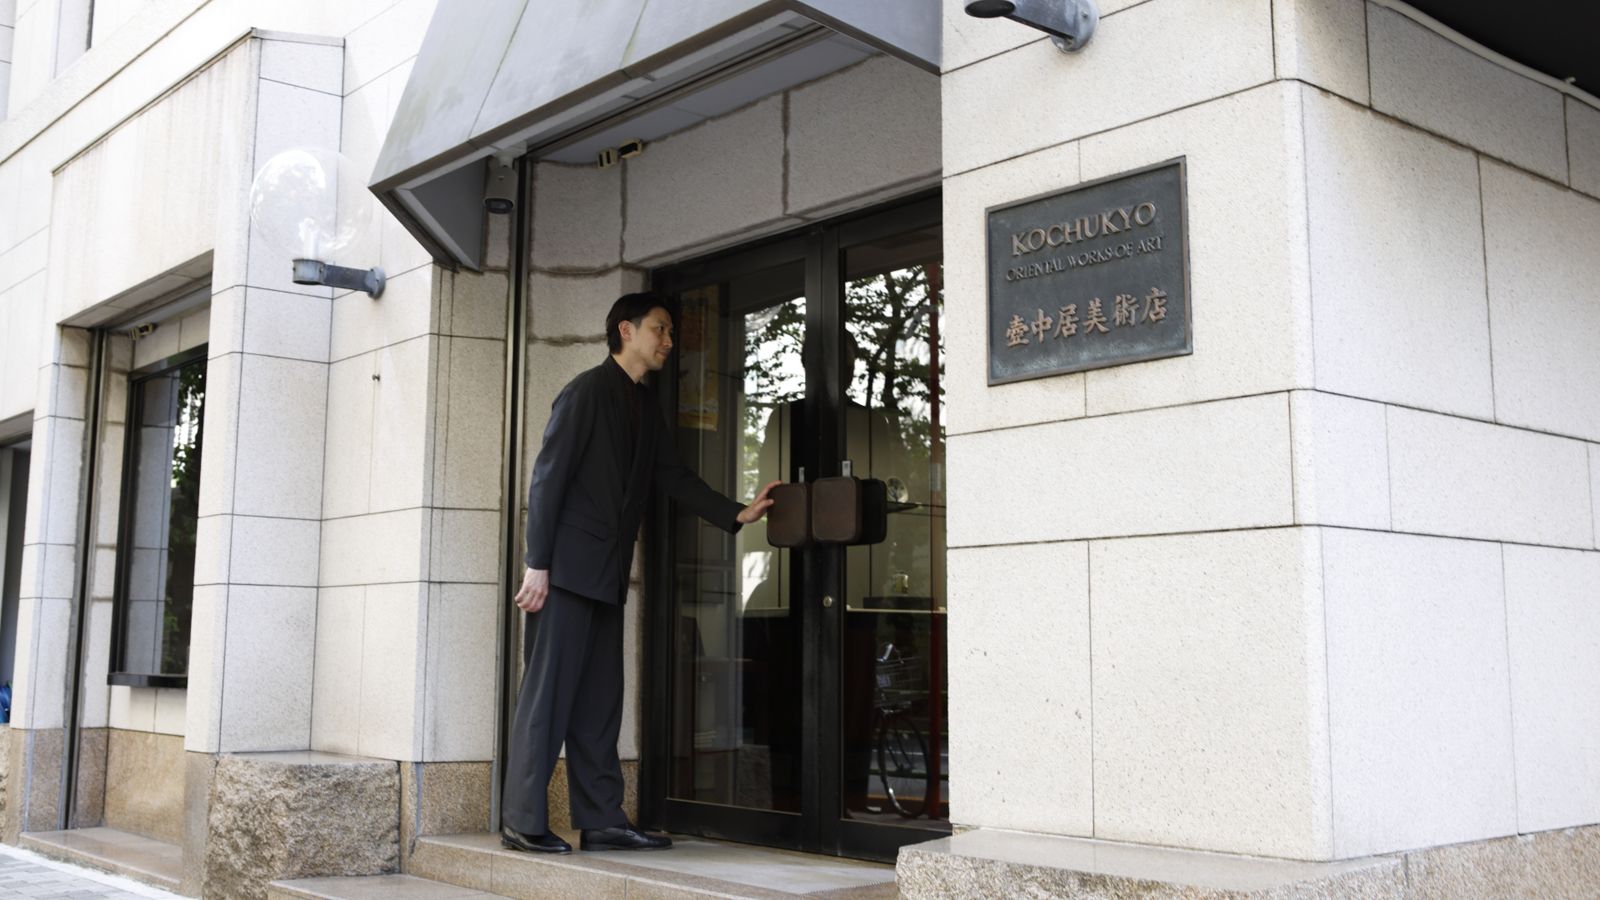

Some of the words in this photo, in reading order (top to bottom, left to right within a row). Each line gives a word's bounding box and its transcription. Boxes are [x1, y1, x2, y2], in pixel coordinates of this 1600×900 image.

[1012, 202, 1156, 256] KOCHUKYO
[1006, 260, 1065, 282] ORIENTAL
[1069, 248, 1112, 268] WORKS
[1113, 243, 1134, 260] OF
[1136, 236, 1164, 256] ART
